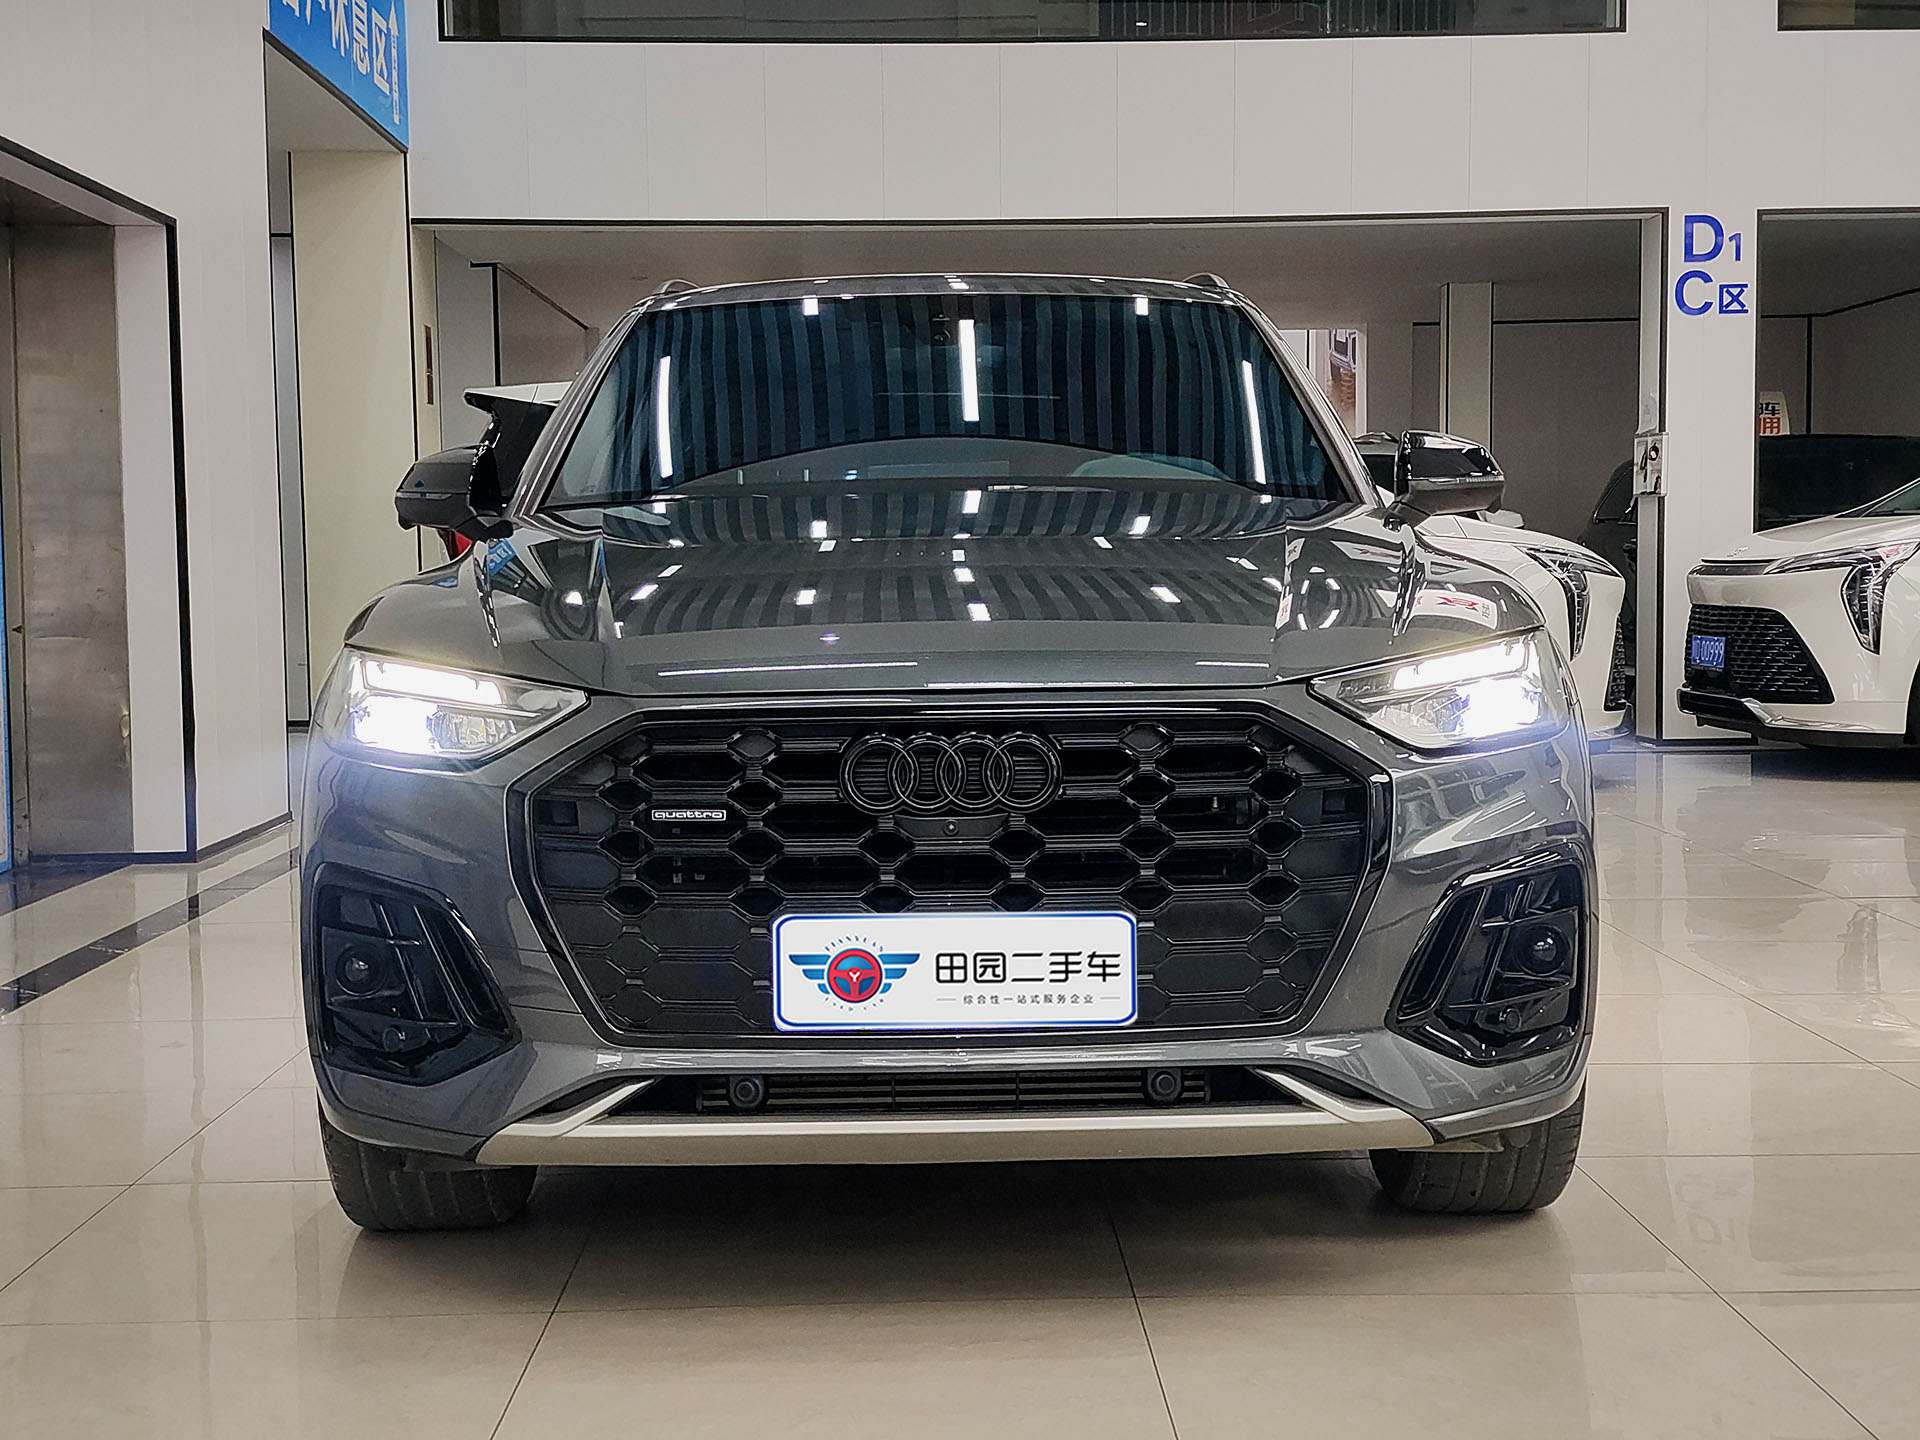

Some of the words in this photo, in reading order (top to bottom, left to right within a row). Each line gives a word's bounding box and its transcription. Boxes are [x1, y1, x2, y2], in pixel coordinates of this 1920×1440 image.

[1683, 214, 1742, 263] D1
[1674, 270, 1749, 316] C区
[654, 811, 723, 819] quattro
[935, 951, 1121, 983] 田园二手车
